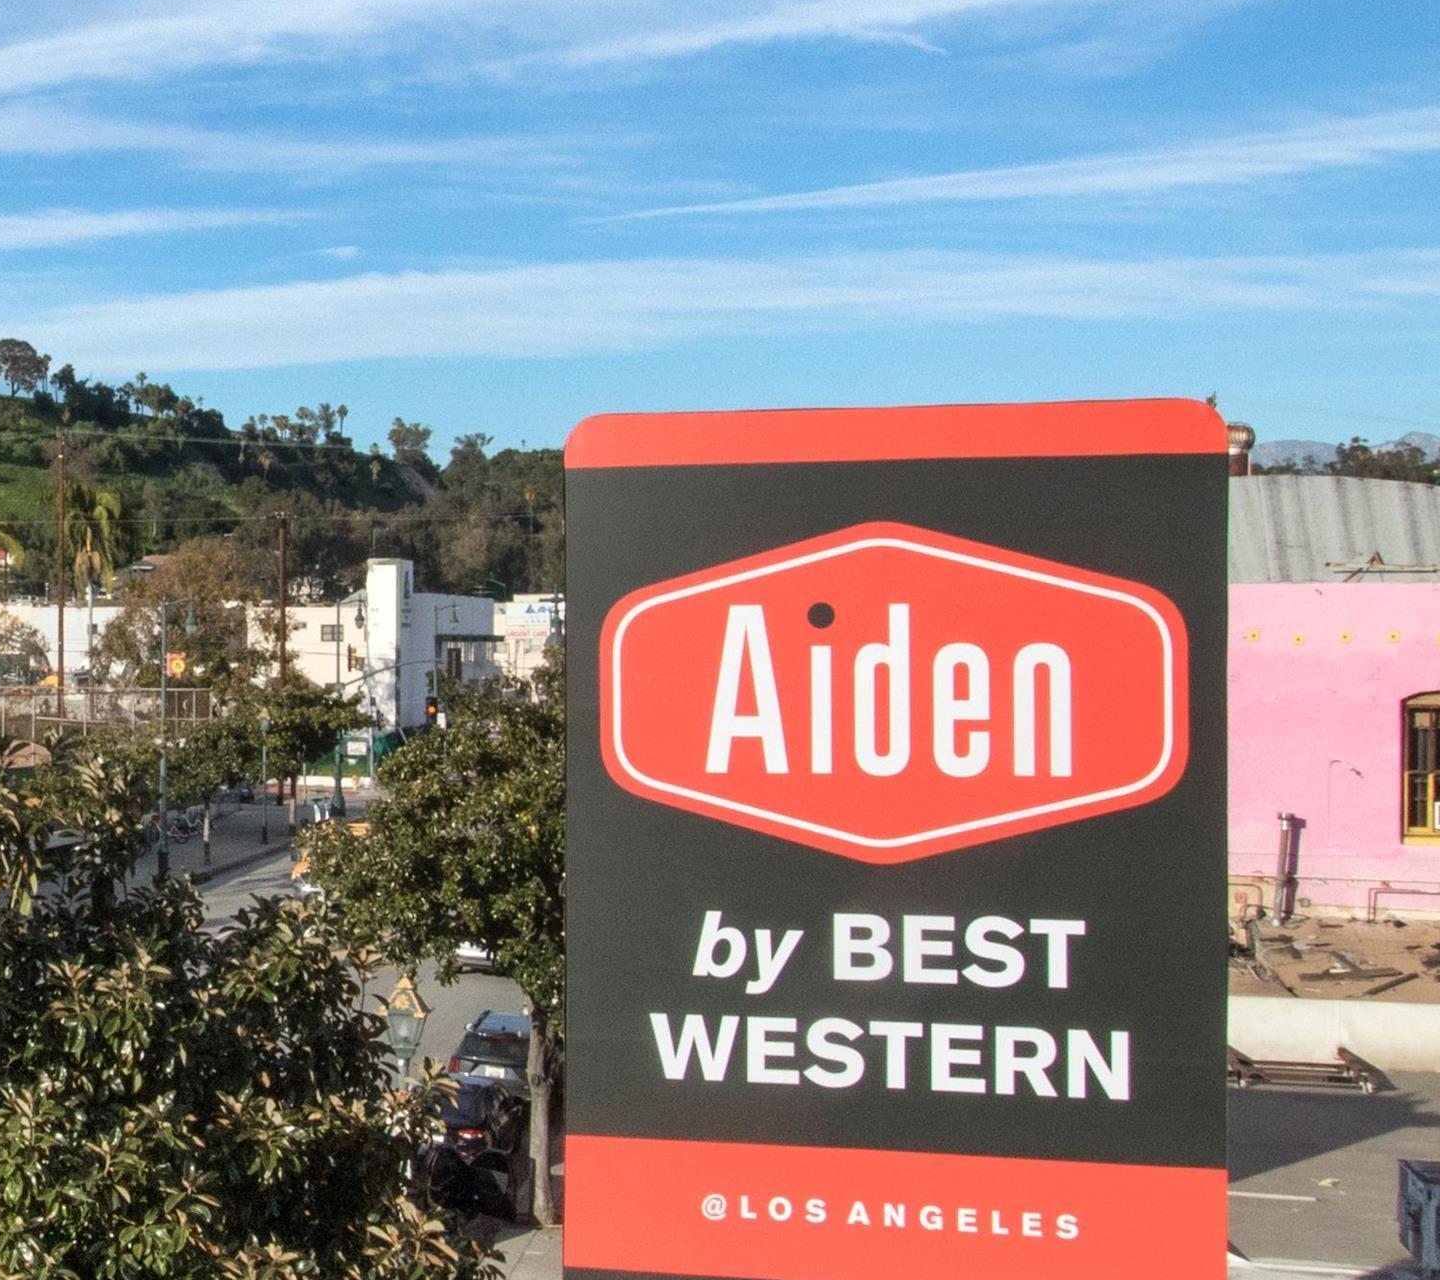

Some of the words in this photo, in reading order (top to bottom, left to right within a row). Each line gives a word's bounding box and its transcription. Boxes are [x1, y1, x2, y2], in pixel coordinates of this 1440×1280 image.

[706, 602, 1072, 778] Aiden
[692, 910, 804, 995] by
[833, 913, 1087, 989] BEST
[649, 1012, 1131, 1101] WESTERN
[700, 1193, 827, 1223] @LOS
[846, 1200, 1080, 1240] ANGELES
